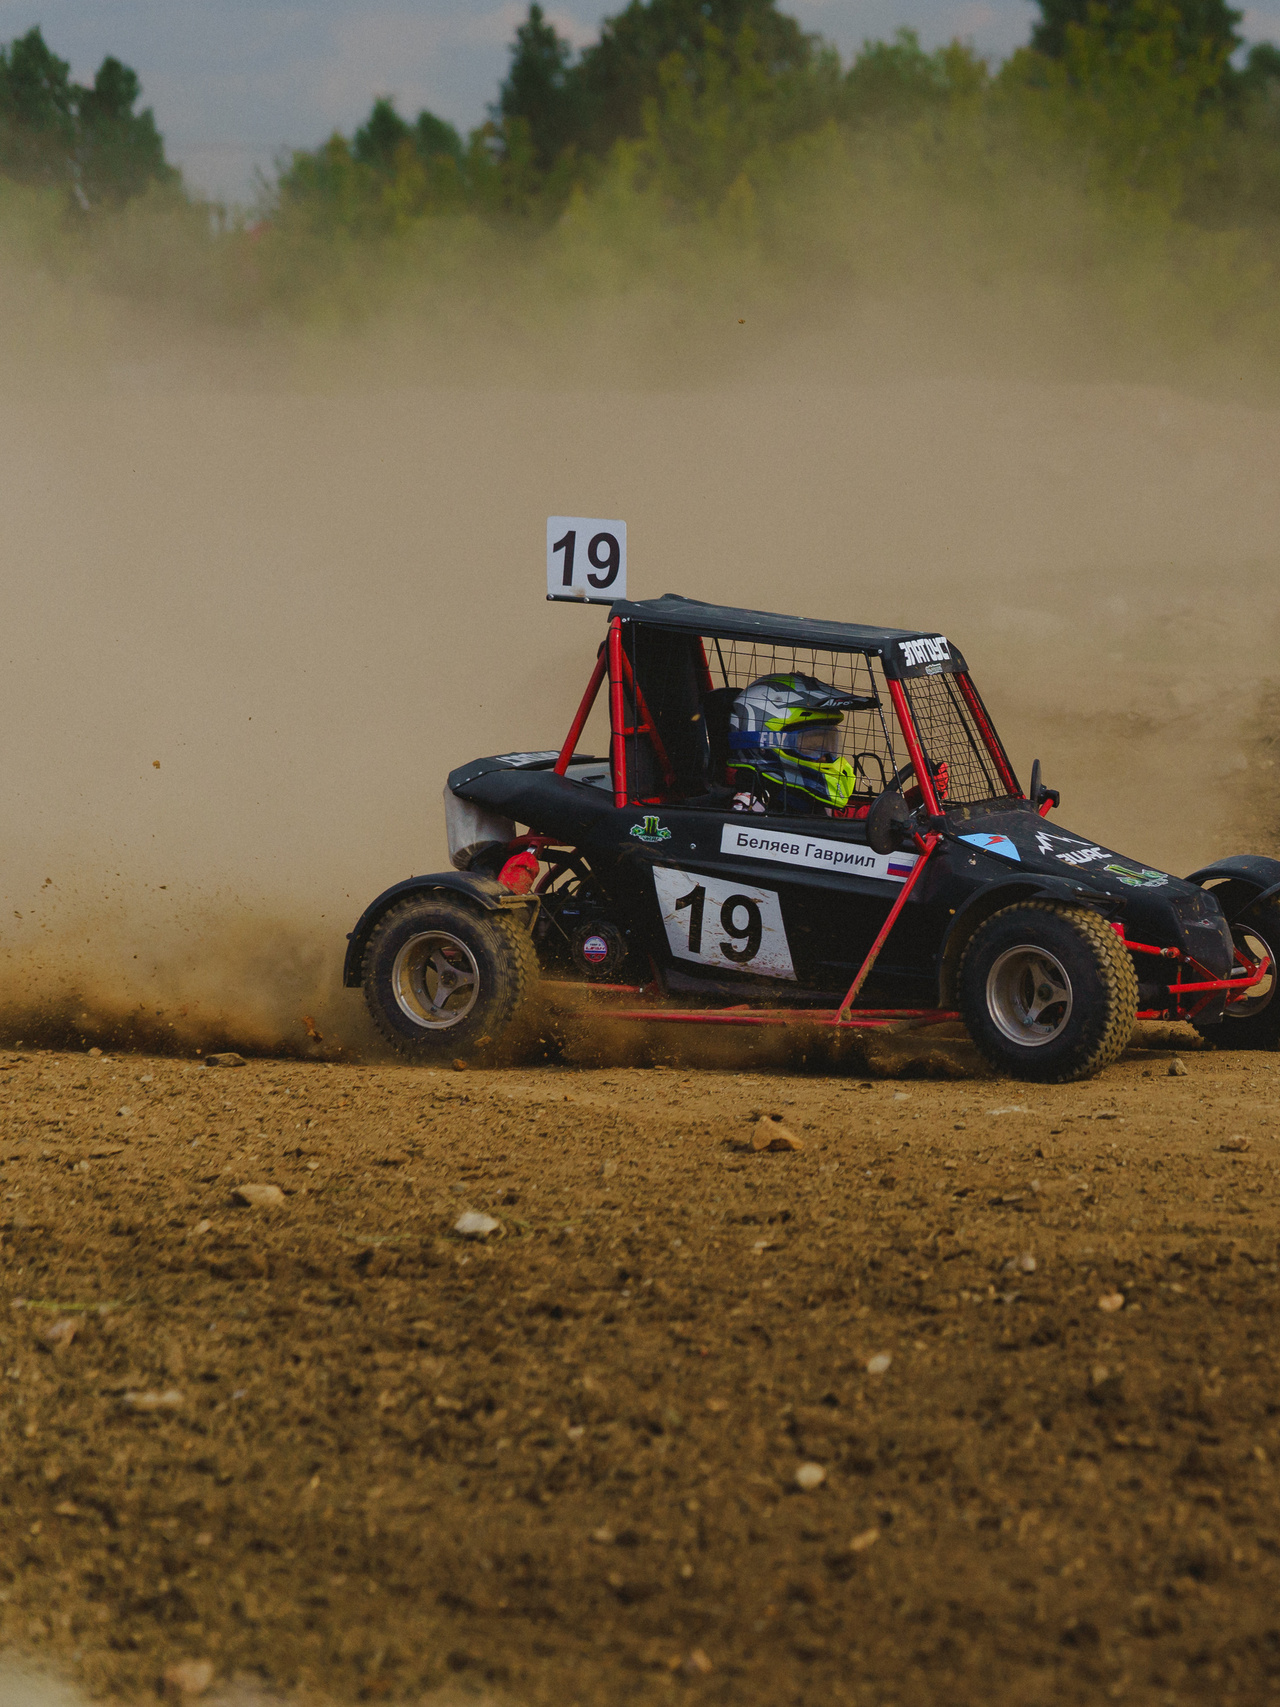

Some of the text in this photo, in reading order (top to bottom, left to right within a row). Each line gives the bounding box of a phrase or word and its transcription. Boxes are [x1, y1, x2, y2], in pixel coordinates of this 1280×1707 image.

[552, 530, 620, 589] 19
[759, 731, 788, 748] FLY
[736, 832, 876, 868] Беляев Гавриил
[675, 885, 763, 963] 19
